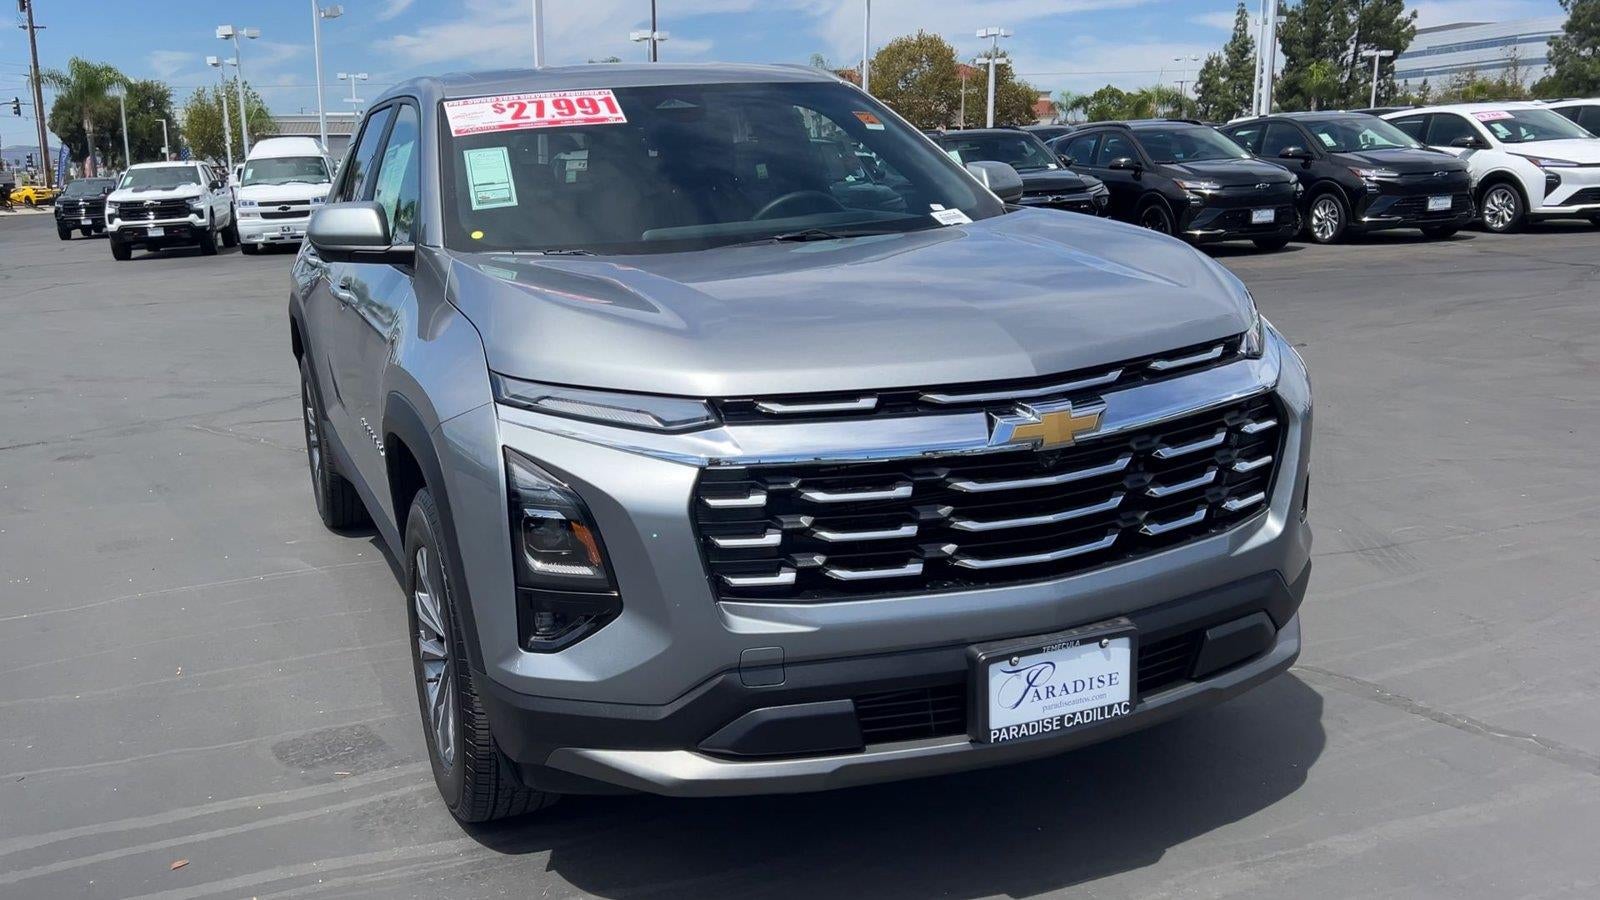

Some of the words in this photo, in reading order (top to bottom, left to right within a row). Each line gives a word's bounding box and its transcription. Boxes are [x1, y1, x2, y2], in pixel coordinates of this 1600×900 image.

[1041, 640, 1081, 653] TEMECULA
[998, 661, 1120, 709] PARADISE
[1042, 692, 1107, 712] paradiseautos.com
[990, 716, 1060, 743] PARADISE
[1064, 701, 1130, 727] CADILLAC
